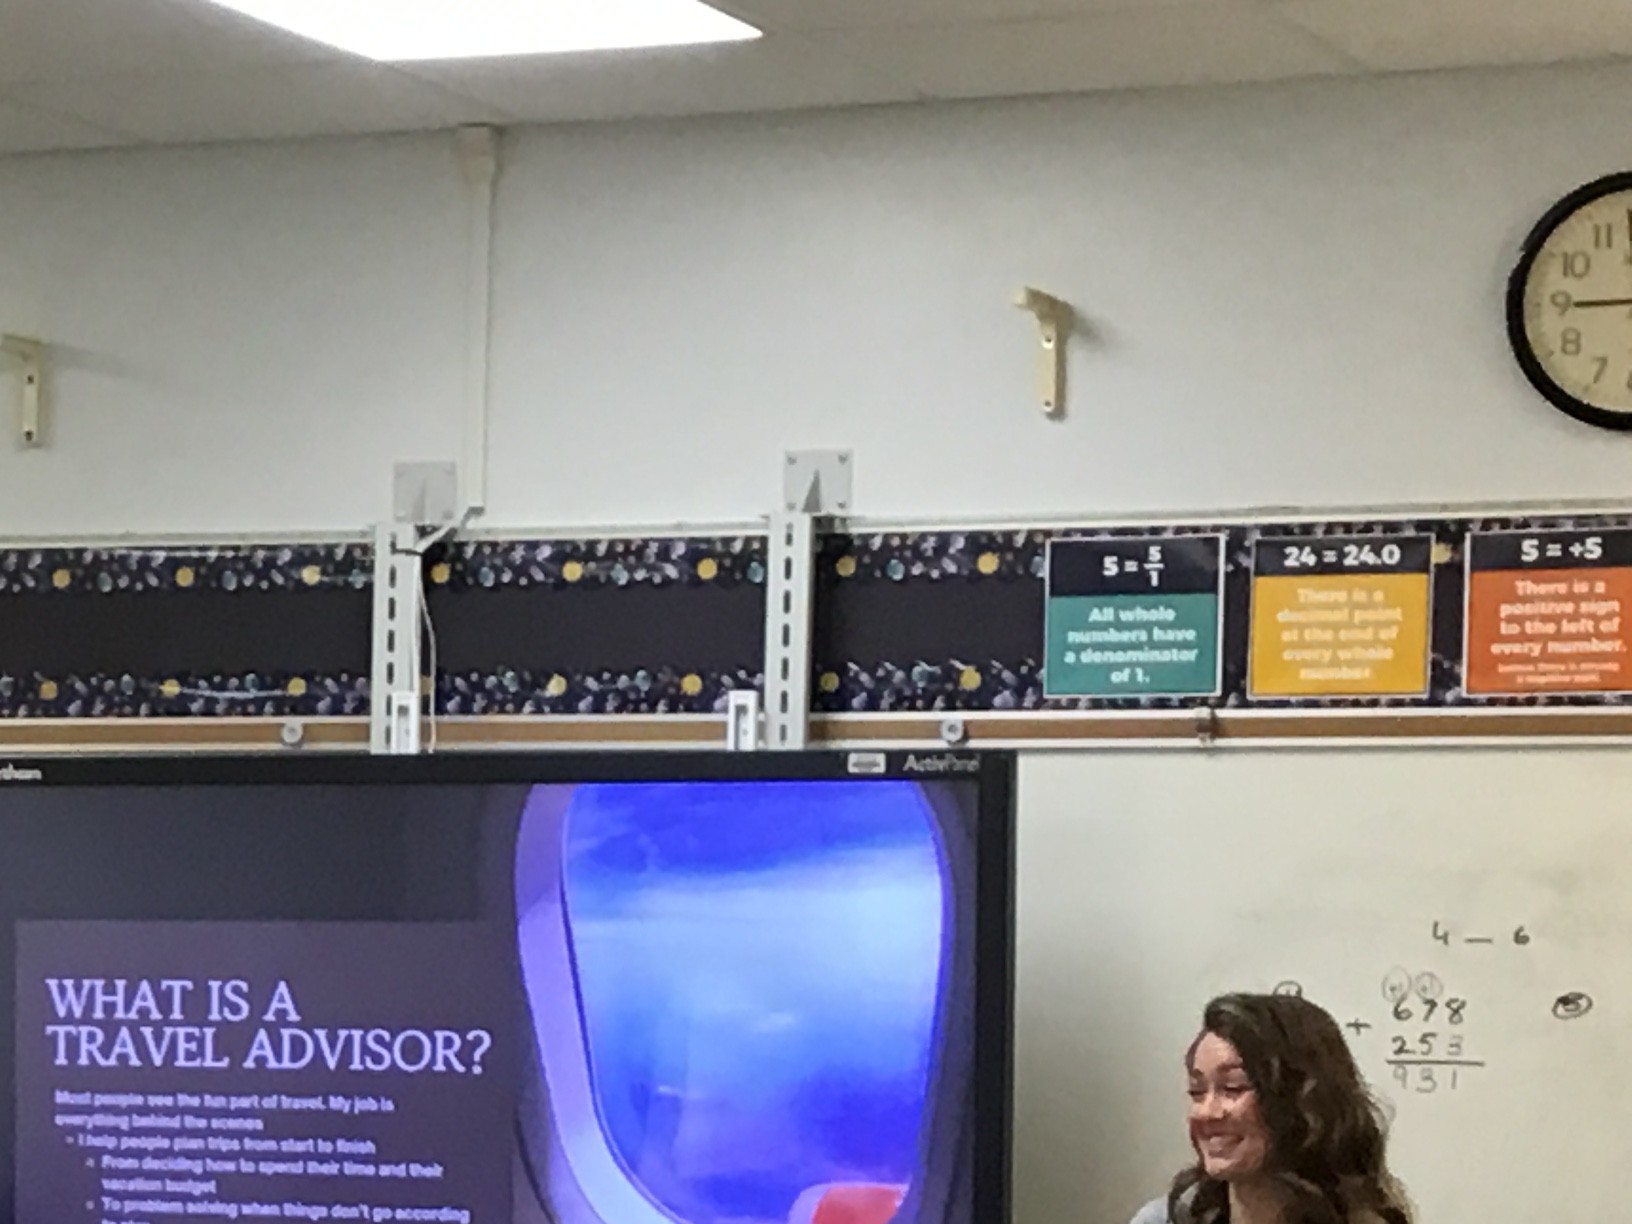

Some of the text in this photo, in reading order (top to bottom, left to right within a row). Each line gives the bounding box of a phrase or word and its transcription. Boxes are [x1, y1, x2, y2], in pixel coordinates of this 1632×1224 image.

[1594, 223, 1613, 248] 11
[1561, 251, 1591, 279] 10
[1550, 290, 1572, 316] 9
[1560, 327, 1582, 356] 8
[1592, 356, 1608, 385] 7
[1283, 546, 1317, 567] 24
[1342, 544, 1401, 566] 24.0
[1521, 538, 1540, 562] 5
[1102, 556, 1119, 576] 5
[1515, 580, 1606, 596] There is a
[1088, 606, 1176, 622] All whole
[1500, 600, 1621, 619] positive sign
[1067, 626, 1197, 643] numbers have
[1500, 616, 1621, 635] to the left of
[1064, 646, 1198, 663] a denominator
[1490, 641, 1543, 657] every
[1110, 667, 1131, 683] of
[1432, 921, 1450, 945] 4
[1513, 925, 1530, 945] 6
[45, 978, 302, 1022] WHAT IS A
[45, 1025, 492, 1075] TRAVEL ADVISOR?
[54, 1089, 395, 1114] Most people see the fun part of travel. My job is
[54, 1114, 264, 1130] everything behind the scenes
[85, 1134, 117, 1149] help
[120, 1135, 171, 1150] people
[173, 1136, 205, 1151] plan
[207, 1136, 240, 1152] trips
[243, 1137, 278, 1150] from
[279, 1138, 314, 1152] start
[317, 1138, 334, 1153] to
[335, 1139, 376, 1154] finish
[101, 1154, 444, 1178] From deciding how to spend their time and their
[101, 1177, 217, 1196] vacation budget
[101, 1197, 121, 1211] To
[123, 1199, 184, 1214] problem
[186, 1201, 238, 1219] solving
[241, 1202, 281, 1216] when
[283, 1202, 328, 1221] things
[330, 1202, 369, 1219] don't
[372, 1206, 393, 1223] go
